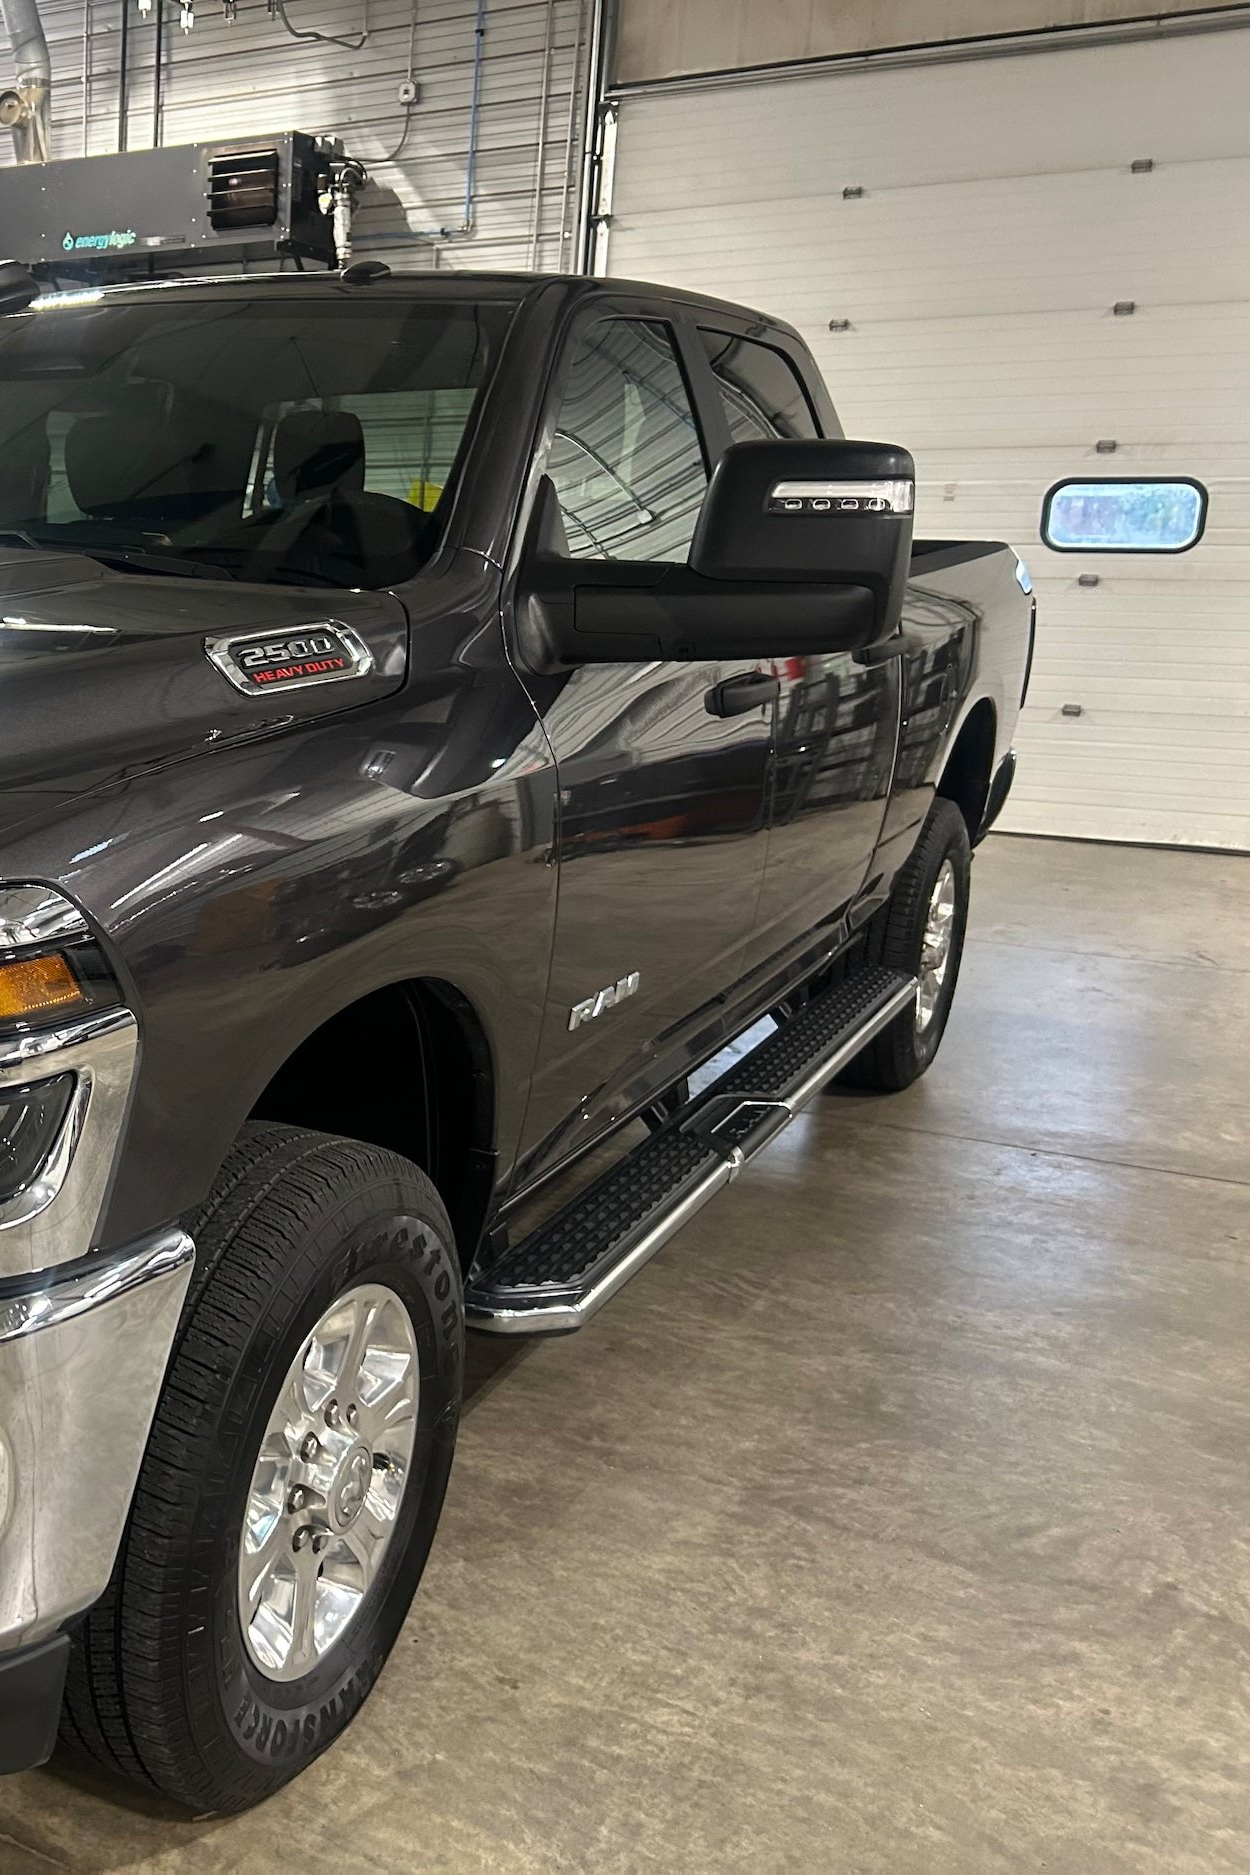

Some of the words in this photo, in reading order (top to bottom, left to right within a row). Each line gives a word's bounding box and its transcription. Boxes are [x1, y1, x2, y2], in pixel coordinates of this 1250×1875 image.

[74, 229, 137, 249] energylogic
[238, 636, 336, 667] 2500
[253, 664, 306, 683] HEAVY
[306, 658, 345, 673] DUTY
[568, 971, 640, 1031] RAM
